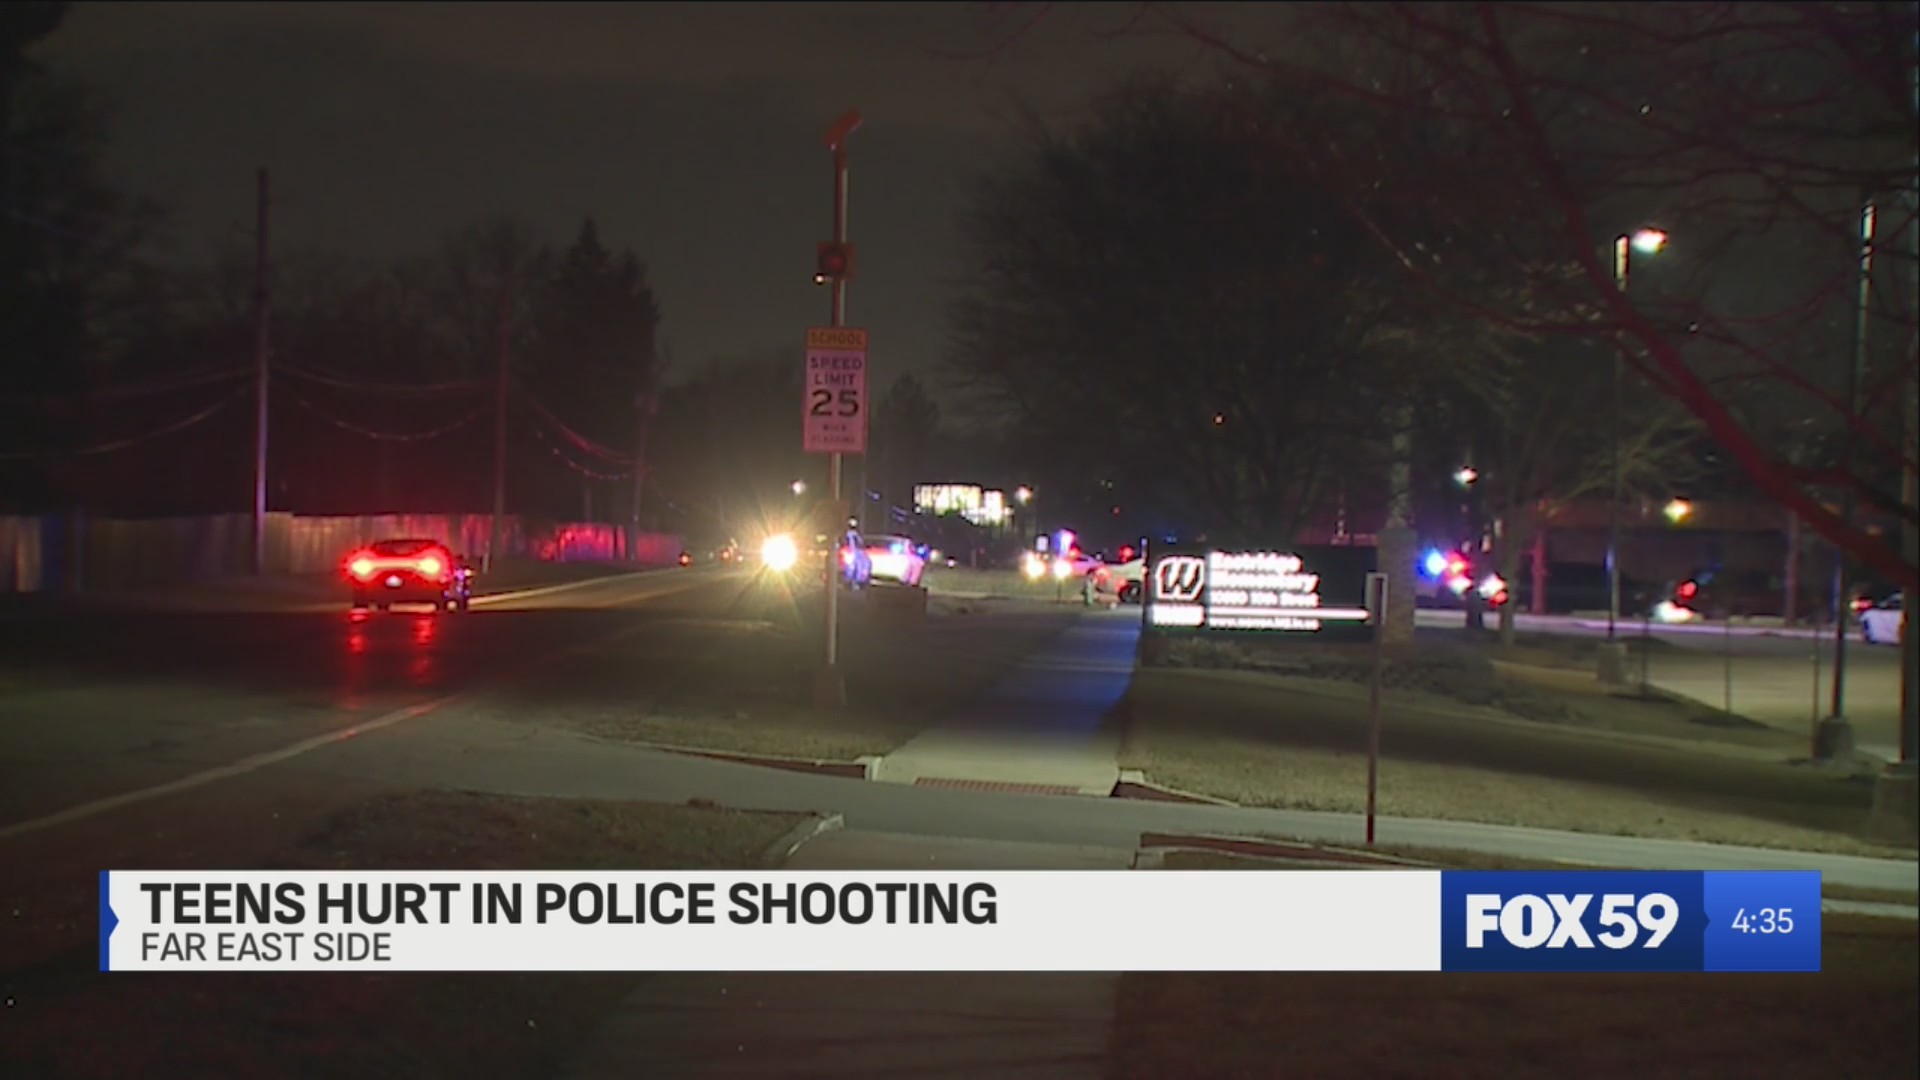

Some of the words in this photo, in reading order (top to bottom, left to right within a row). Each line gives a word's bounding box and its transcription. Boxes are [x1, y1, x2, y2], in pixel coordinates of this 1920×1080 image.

[810, 331, 864, 344] SCHOOL
[810, 356, 863, 370] SPEED
[814, 373, 855, 385] LIMIT
[811, 389, 860, 417] 25
